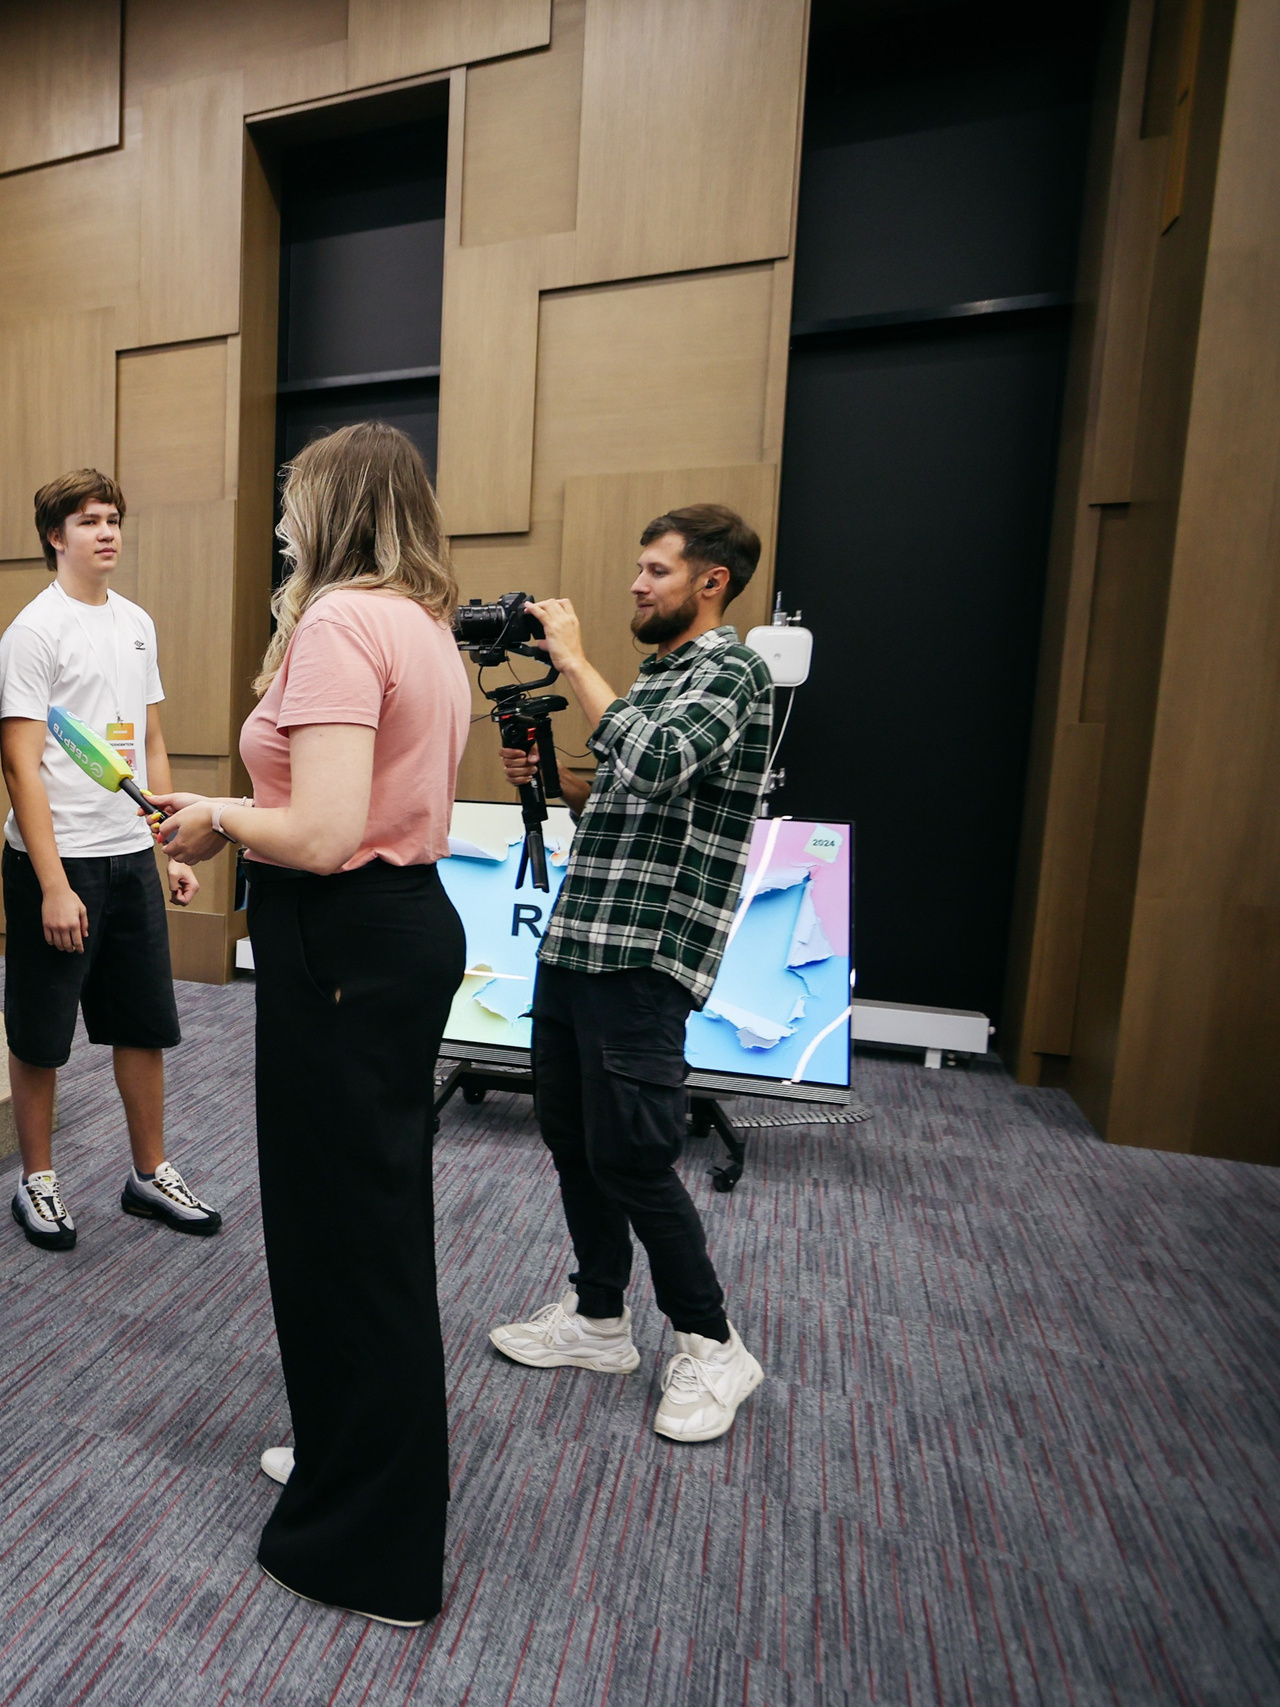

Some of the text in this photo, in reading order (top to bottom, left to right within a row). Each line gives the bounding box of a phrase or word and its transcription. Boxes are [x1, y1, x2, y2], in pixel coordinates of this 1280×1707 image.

[53, 723, 89, 764] СБЕР ТВ
[812, 839, 835, 847] 2024
